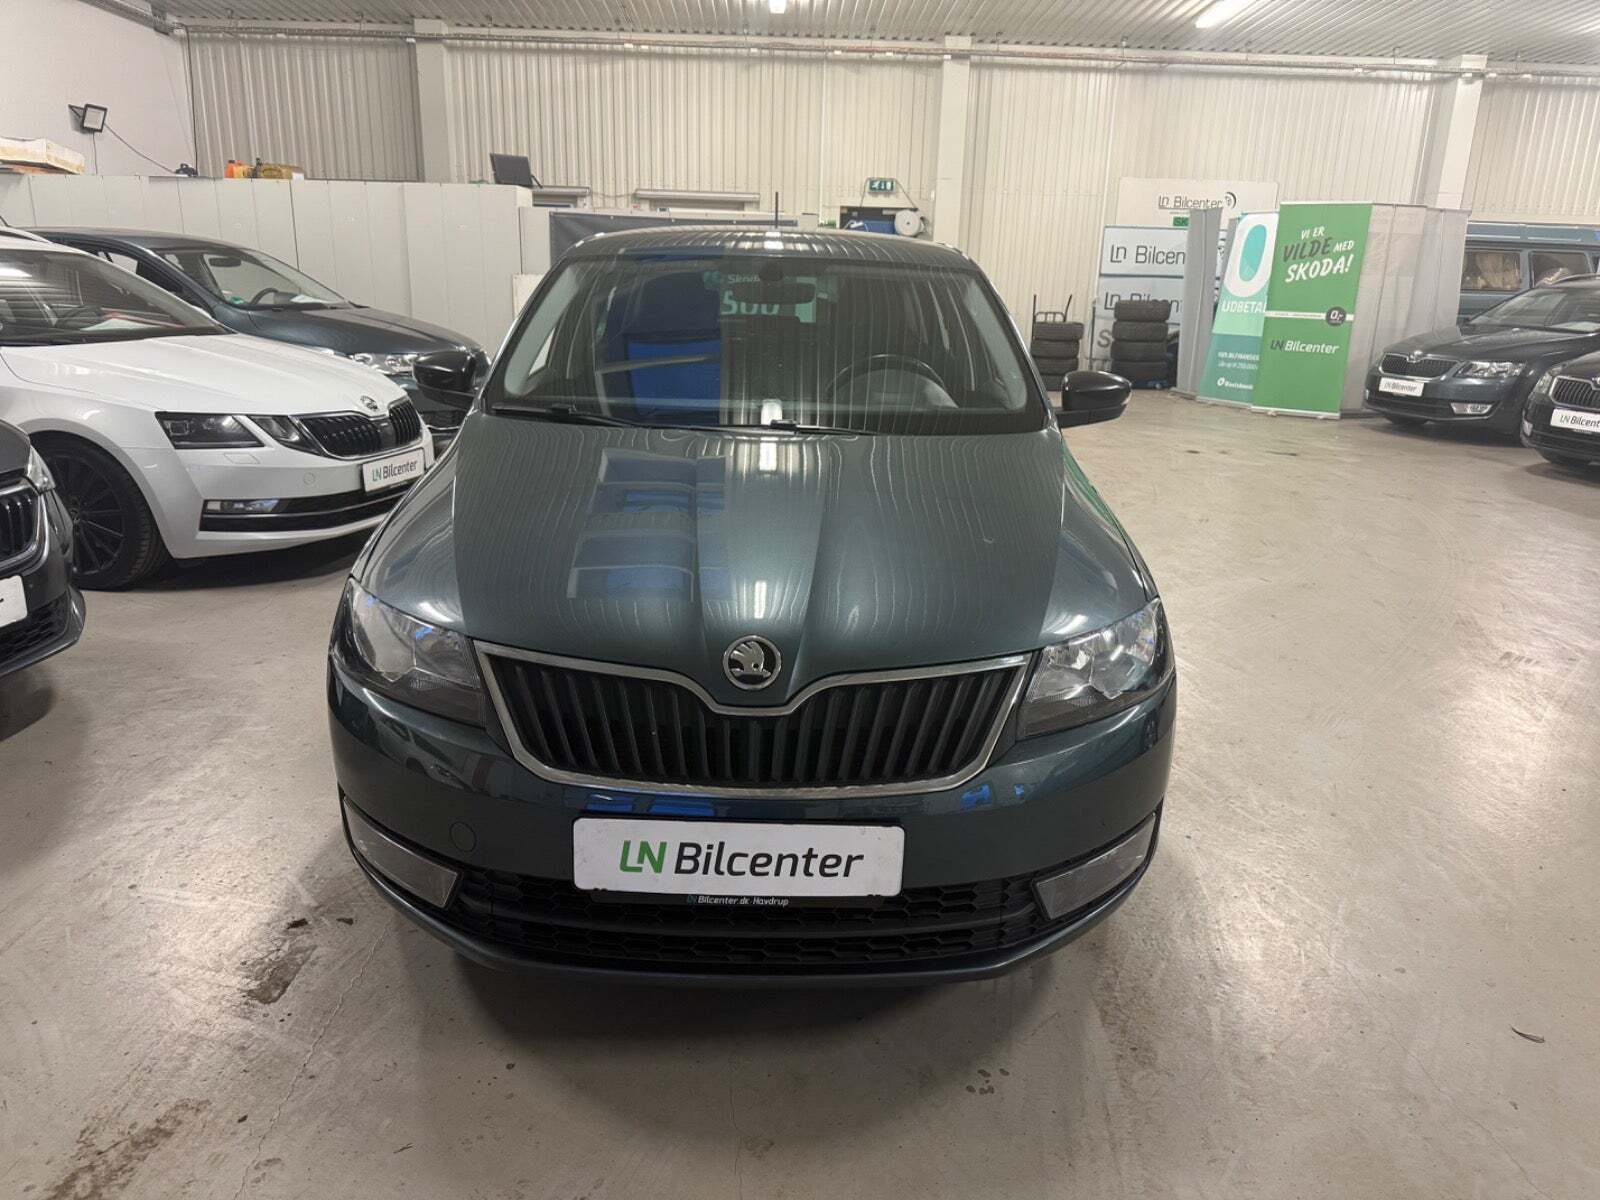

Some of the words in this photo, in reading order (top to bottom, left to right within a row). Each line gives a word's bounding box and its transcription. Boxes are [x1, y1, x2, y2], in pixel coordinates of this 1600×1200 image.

[1173, 195, 1223, 209] Bilcenter
[1301, 228, 1311, 240] VI
[1313, 226, 1325, 237] ER
[1135, 245, 1186, 265] Bilcen
[1283, 237, 1333, 262] VILDE
[1333, 240, 1354, 253] MED
[1285, 254, 1354, 282] SKODA!
[1284, 340, 1340, 354] Bilcenter
[383, 460, 417, 479] Bilcenter
[619, 840, 667, 874] LN
[674, 841, 864, 877] Bilcenter
